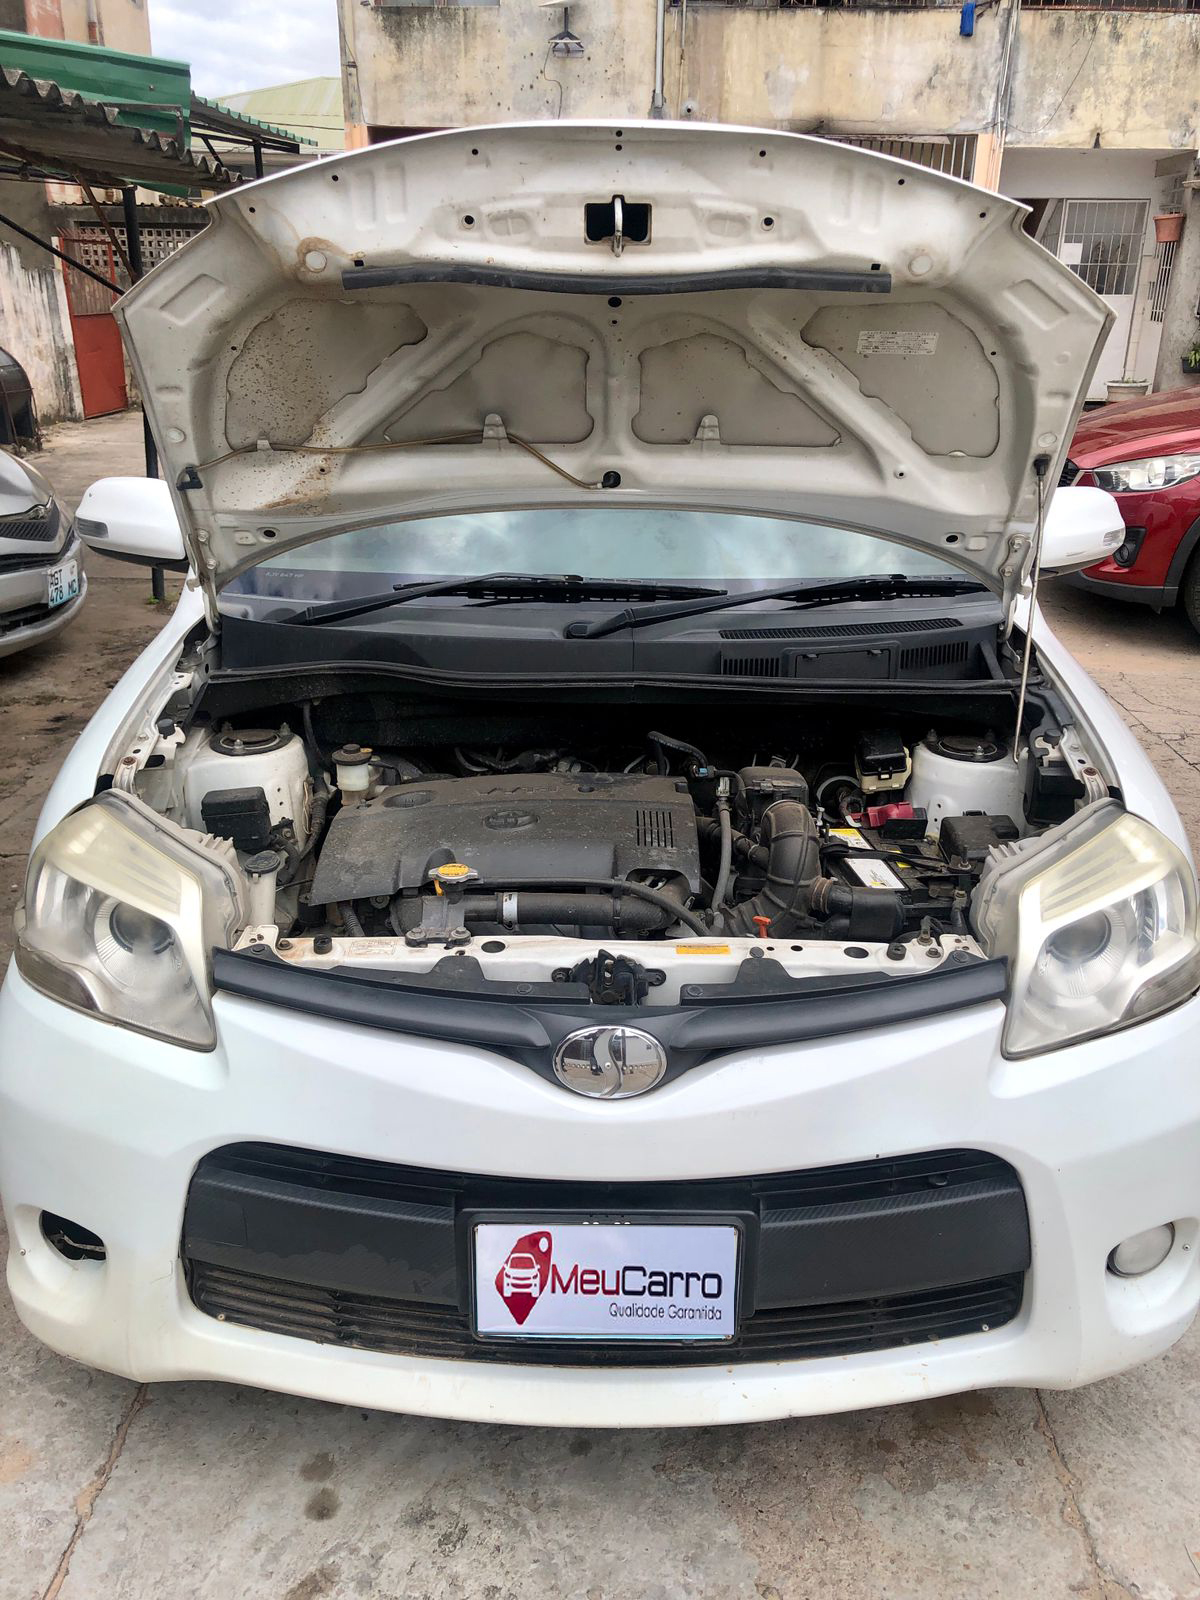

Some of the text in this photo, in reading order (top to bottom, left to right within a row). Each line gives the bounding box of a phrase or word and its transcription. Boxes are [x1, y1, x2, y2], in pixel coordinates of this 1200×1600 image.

[50, 569, 62, 587] AGT
[50, 579, 77, 603] 478 MC
[551, 1263, 722, 1298] MeuCarro
[609, 1303, 722, 1321] Qualidade Garantida
